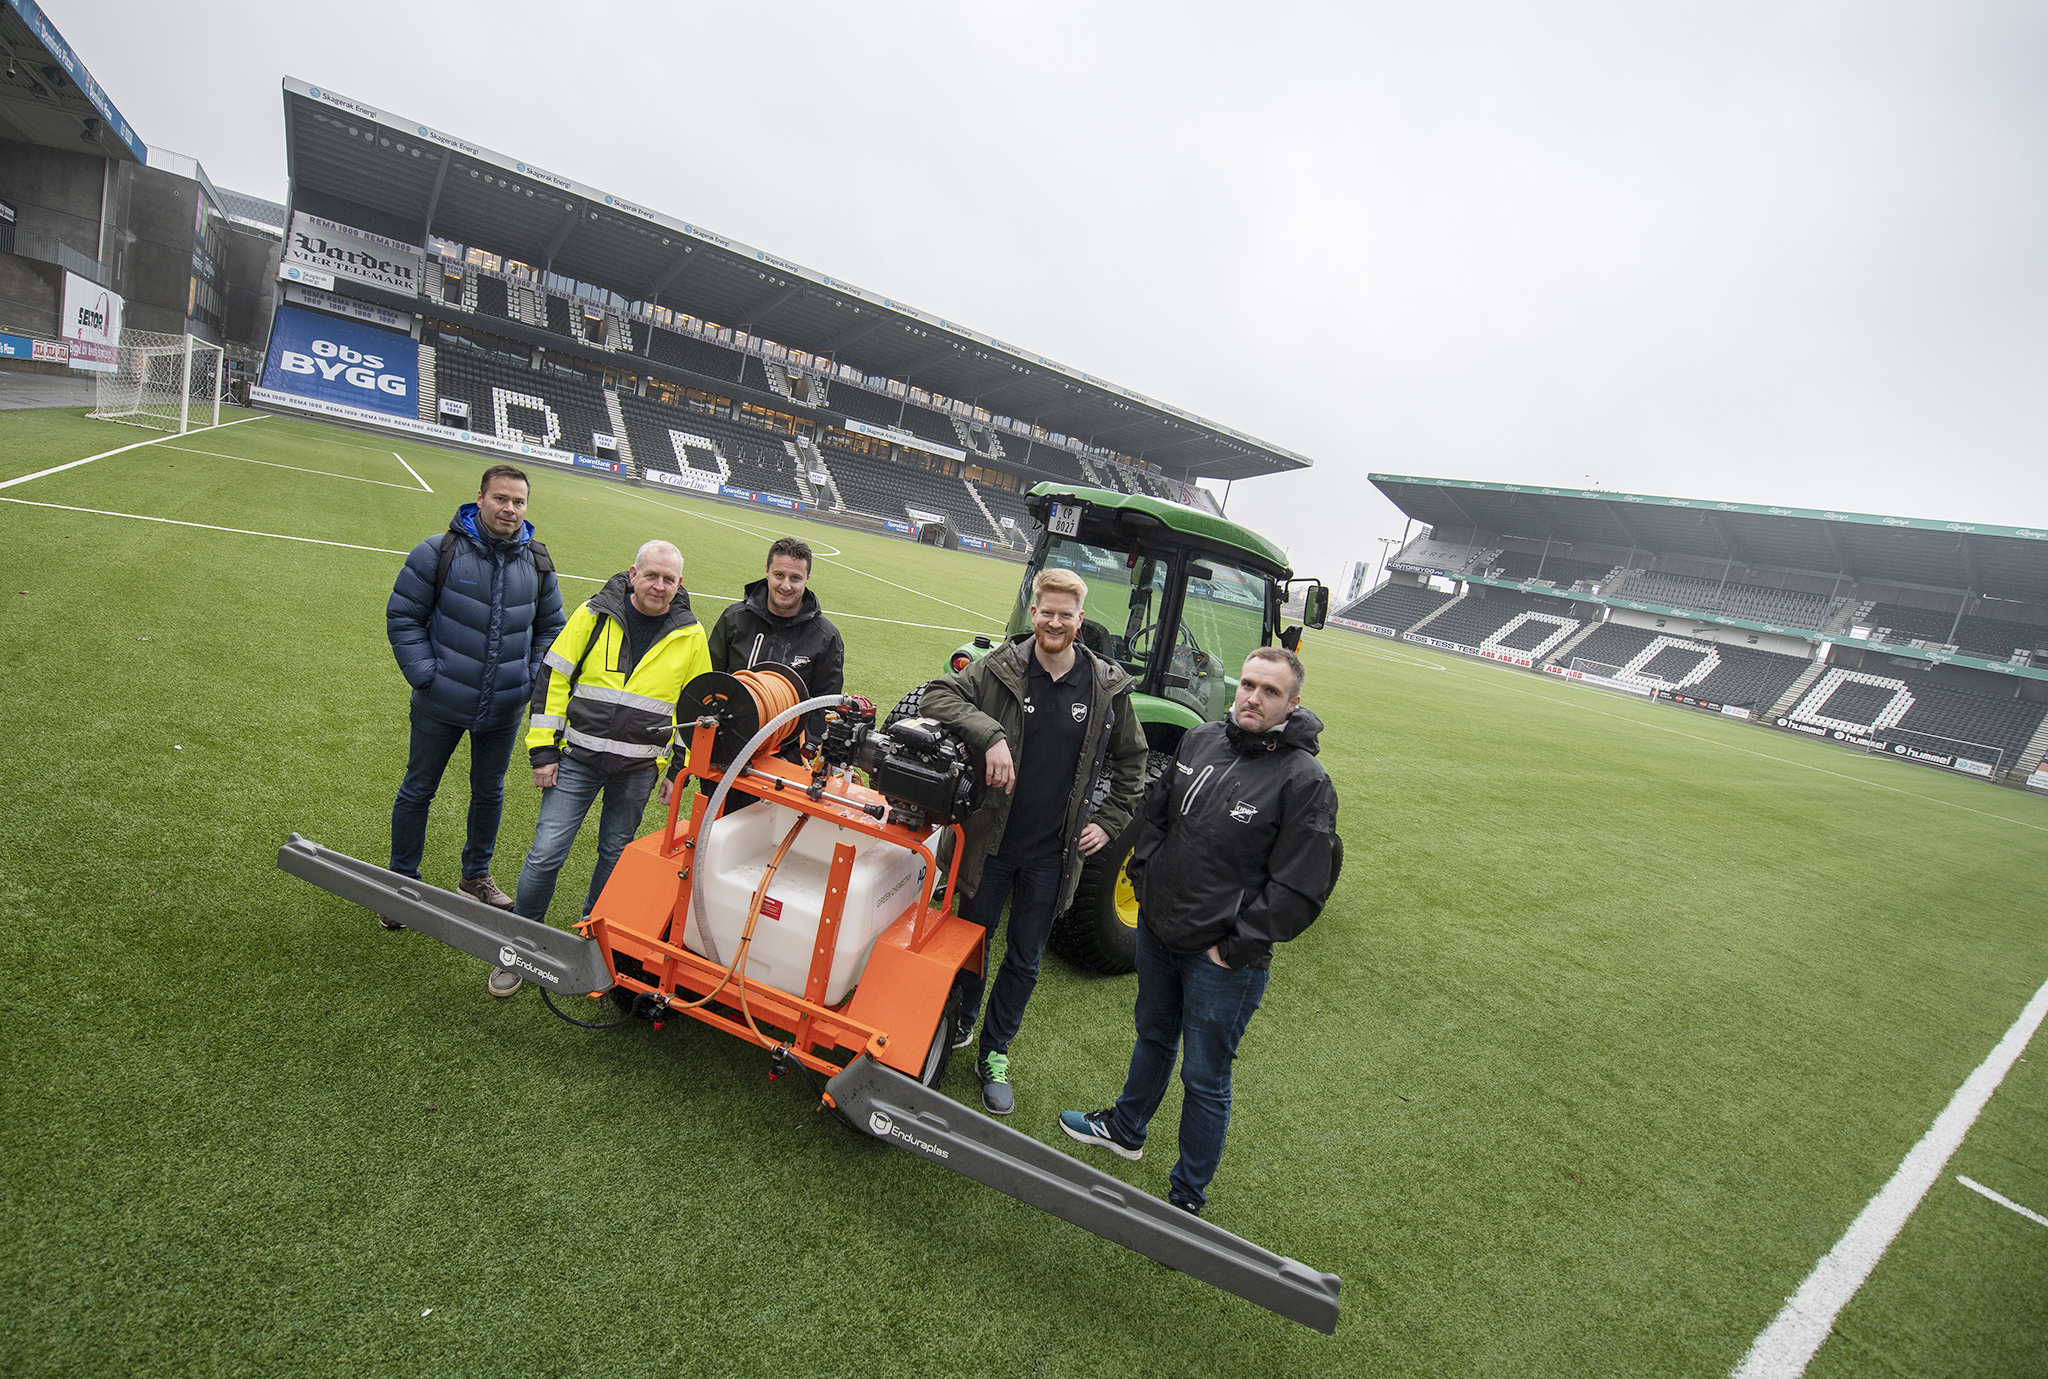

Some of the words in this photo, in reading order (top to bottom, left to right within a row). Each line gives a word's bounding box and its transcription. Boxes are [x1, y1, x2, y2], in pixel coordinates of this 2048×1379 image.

[322, 92, 354, 110] Skagerak
[355, 104, 378, 118] Energi
[429, 131, 458, 147] Skagerak
[459, 142, 479, 155] Energi
[526, 167, 552, 182] Skagerak
[553, 177, 571, 190] Energi
[613, 199, 637, 213] Skagerak
[638, 208, 655, 220] Energi
[309, 216, 336, 231] REMA
[338, 224, 359, 237] 1000
[364, 232, 390, 246] REMA
[391, 240, 411, 252] 1000
[693, 228, 714, 242] Skagerak
[715, 236, 730, 247] Energi
[294, 232, 413, 280] Varden
[293, 250, 308, 260] VI
[312, 257, 332, 267] ER
[334, 261, 414, 290] TELEMARK
[302, 270, 328, 283] Skagerak
[446, 264, 463, 273] REMA
[302, 276, 319, 286] Energi
[301, 288, 325, 300] REMA
[327, 294, 350, 307] REMA
[352, 301, 375, 313] REMA
[377, 308, 399, 320] REMA
[441, 257, 465, 268] REMA
[467, 263, 485, 274] 1000
[489, 270, 512, 283] REMA
[514, 277, 531, 289] 1000
[536, 284, 557, 297] REMA
[559, 291, 575, 301] 1000
[579, 298, 600, 309] REMA
[601, 304, 617, 314] 1000
[621, 310, 640, 322] REMA
[660, 322, 679, 333] REMA
[680, 327, 695, 337] 1000
[303, 296, 322, 306] 1000
[329, 302, 347, 312] 1000
[354, 309, 372, 319] 1000
[379, 315, 396, 325] 1000
[280, 350, 406, 397] BYGG
[252, 389, 271, 399] REMA
[272, 393, 287, 402] 1000
[289, 397, 307, 407] REMA
[308, 401, 322, 409] 1000
[326, 405, 343, 414] REMA
[344, 408, 358, 416] 1000
[360, 412, 377, 421] REMA
[378, 415, 391, 423] 1000
[394, 420, 410, 428] REMA
[411, 422, 424, 430] 1000
[426, 426, 442, 434] REMA
[443, 429, 456, 437] 1000
[445, 401, 463, 410] REMA
[598, 435, 612, 443] REMA
[866, 427, 884, 437] Skagerak
[471, 435, 495, 446] Skagerak
[496, 440, 514, 449] Energi
[530, 447, 553, 458] Skagerak
[554, 451, 571, 460] Energi
[578, 455, 611, 468] SpareBank
[722, 486, 750, 497] SpareBank
[766, 495, 792, 506] SpareBank
[1063, 507, 1073, 519] CP
[1056, 520, 1075, 534] 8027
[1387, 562, 1443, 576] KONTORBYGG.no
[1405, 633, 1428, 644] TESS
[1430, 639, 1455, 650] TESS
[1480, 651, 1496, 659] ABB
[1497, 654, 1512, 663] ABB
[1515, 658, 1530, 667] ABB
[1546, 665, 1562, 674] ABB
[1566, 670, 1583, 679] ABB
[1787, 720, 1827, 736] hummel
[1845, 733, 1887, 750] hummel
[1906, 747, 1952, 765] hummel
[515, 956, 559, 984] Enduraplas
[890, 1125, 950, 1159] Enduraplas
